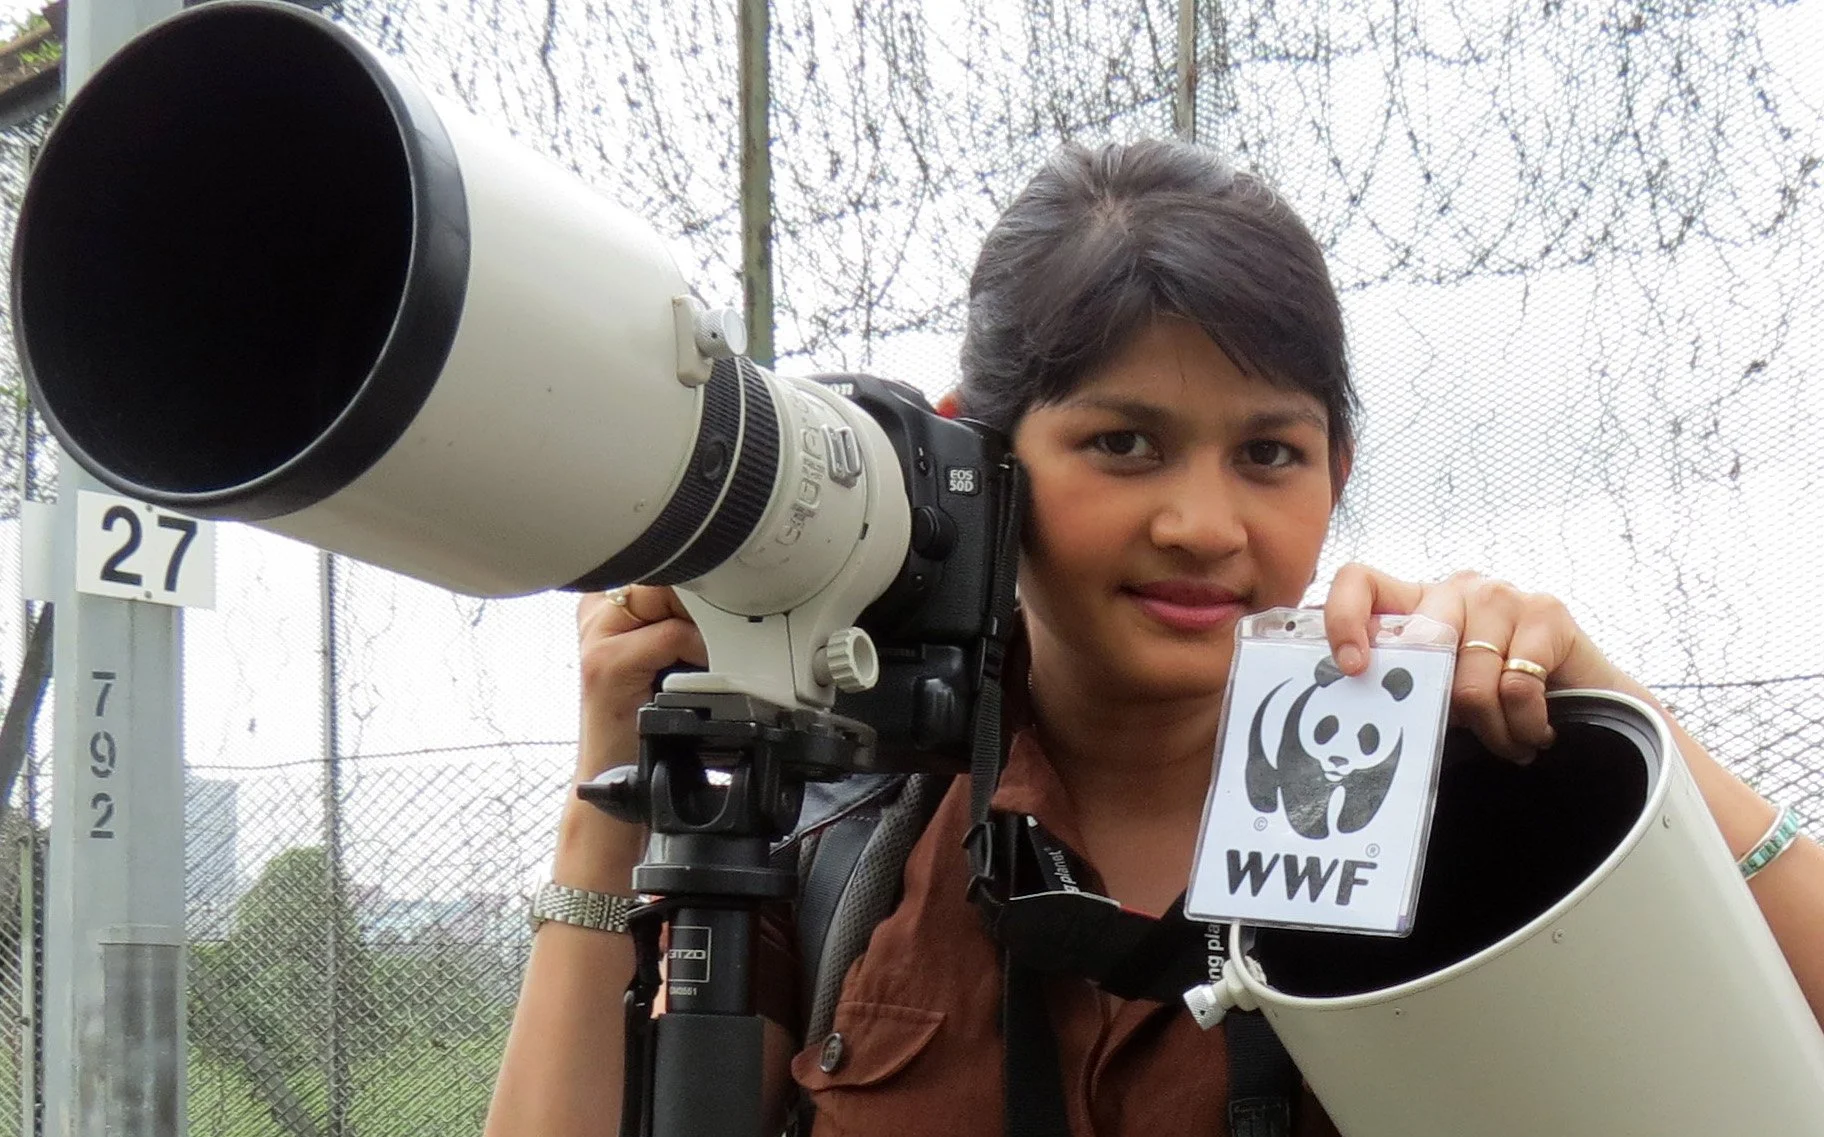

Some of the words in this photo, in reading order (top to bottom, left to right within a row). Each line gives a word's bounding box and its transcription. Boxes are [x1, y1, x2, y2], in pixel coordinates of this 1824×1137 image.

[949, 469, 973, 480] EOS
[949, 480, 974, 493] 50D
[100, 505, 198, 593] 27
[90, 671, 117, 839] 792
[1226, 848, 1378, 906] WWF
